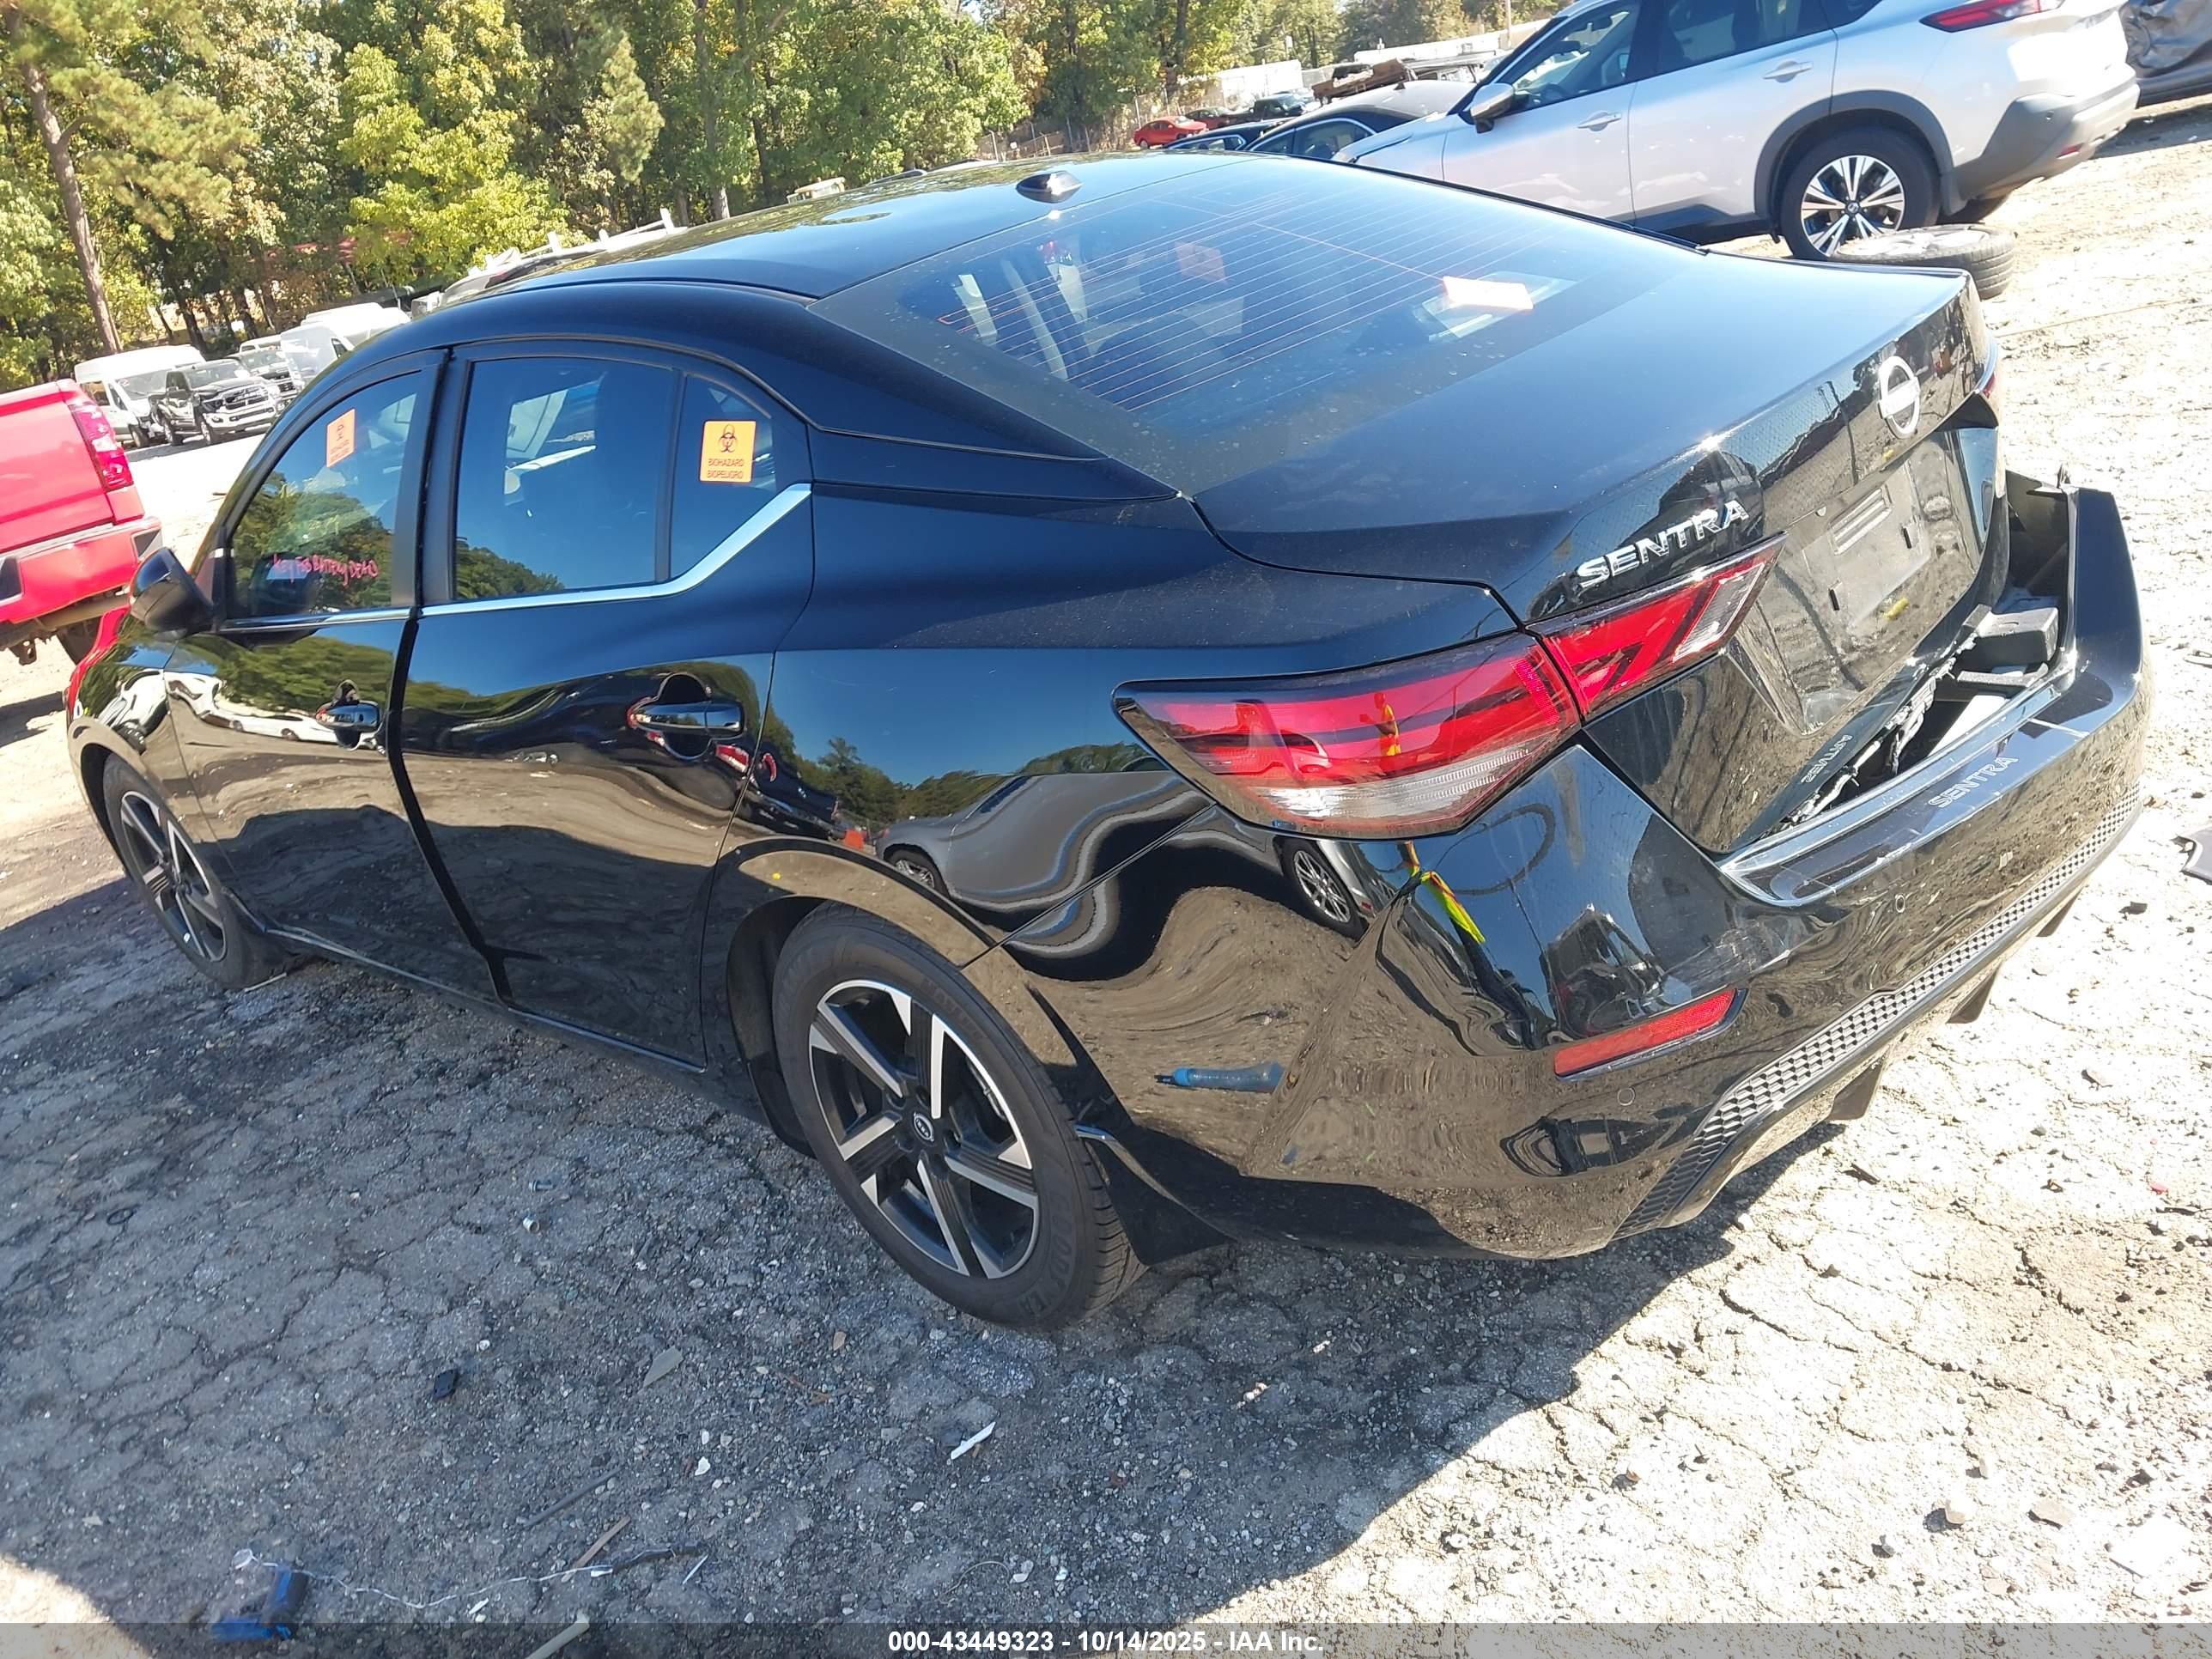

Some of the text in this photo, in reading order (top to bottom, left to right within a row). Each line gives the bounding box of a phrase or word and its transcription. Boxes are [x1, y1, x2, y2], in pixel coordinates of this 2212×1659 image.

[706, 470, 744, 479] BIOPELIGRO
[708, 459, 744, 467] BIOHAZARD
[1577, 500, 1750, 589] SENTRA
[1927, 756, 2020, 808] SENTRA
